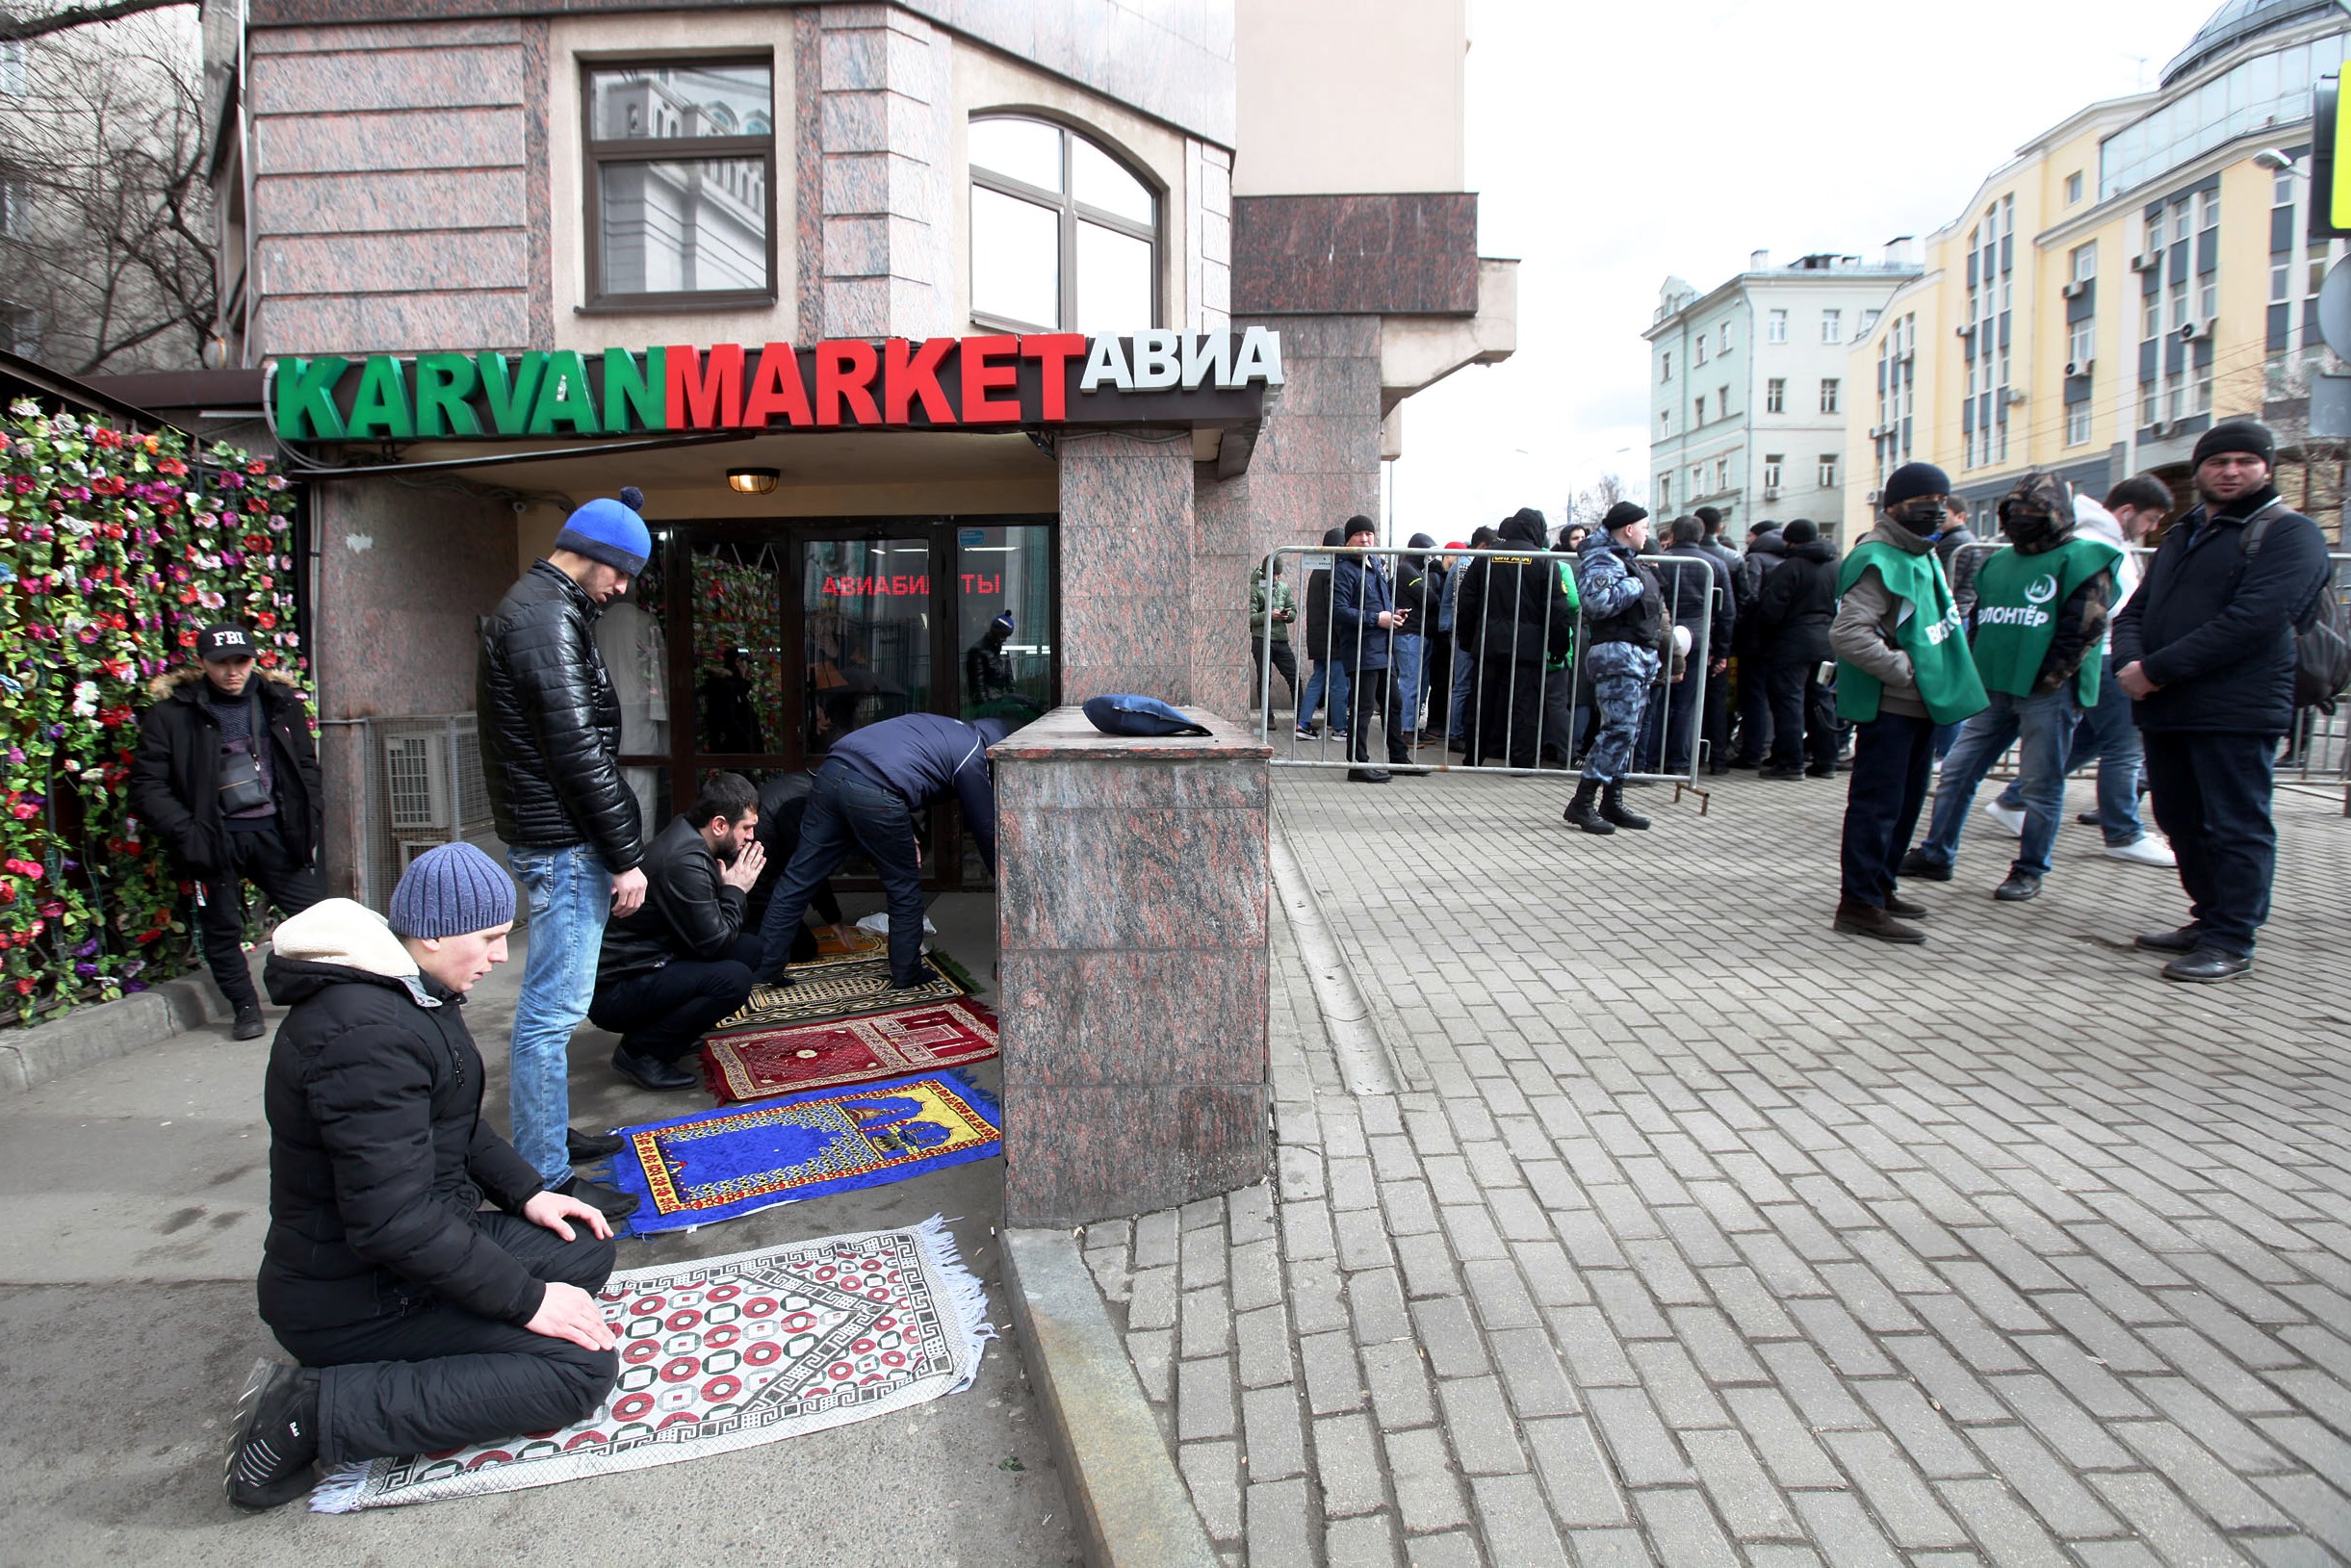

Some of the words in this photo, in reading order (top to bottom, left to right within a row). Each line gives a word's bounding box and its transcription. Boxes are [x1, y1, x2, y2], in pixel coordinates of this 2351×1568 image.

[1079, 325, 1284, 393] АВИА
[821, 574, 1001, 596] АВИАБИТЫ
[213, 630, 246, 646] FBI
